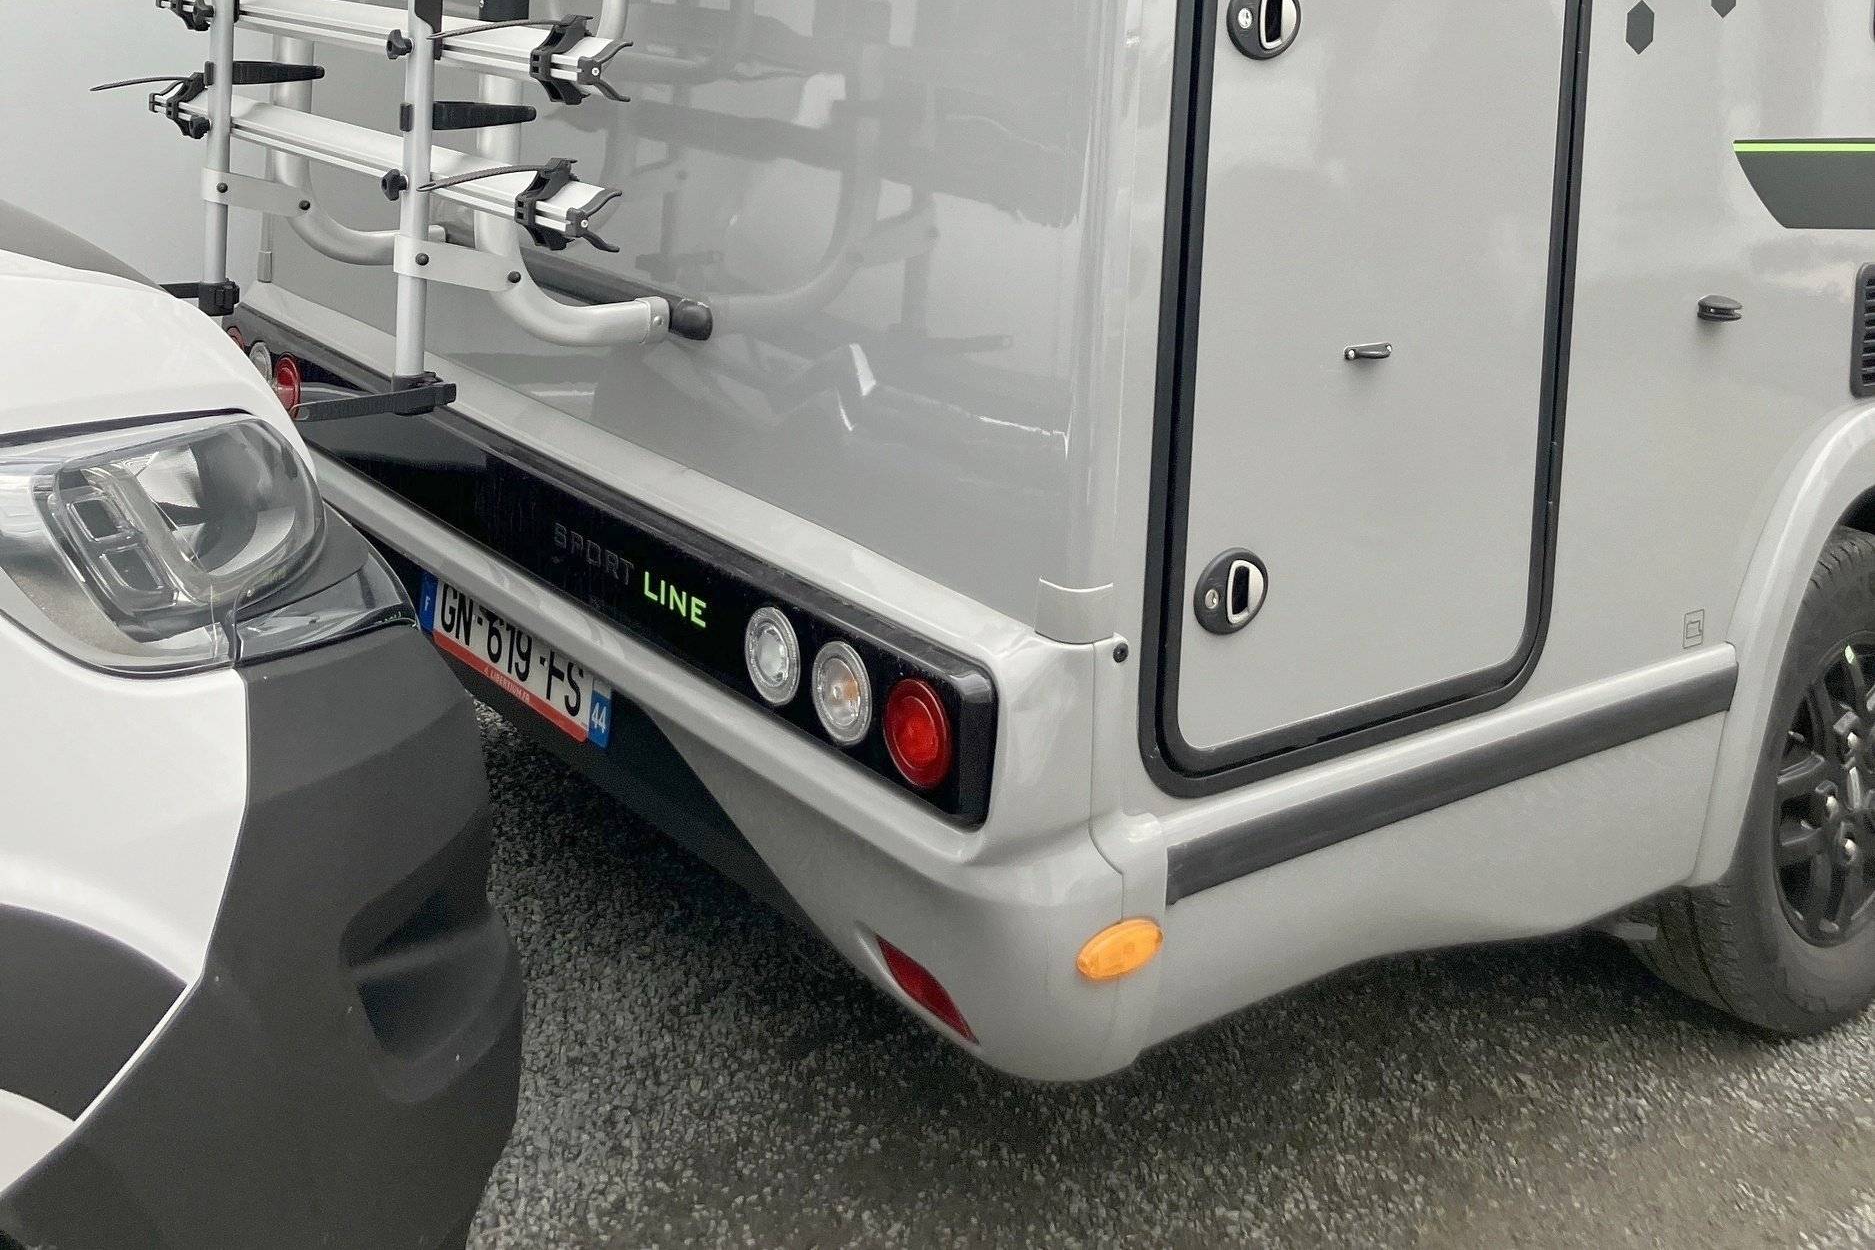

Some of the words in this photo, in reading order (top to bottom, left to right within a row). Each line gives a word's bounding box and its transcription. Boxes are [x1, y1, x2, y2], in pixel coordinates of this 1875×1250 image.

[553, 522, 635, 586] SPORT
[643, 570, 708, 628] LINE
[591, 701, 607, 734] 44
